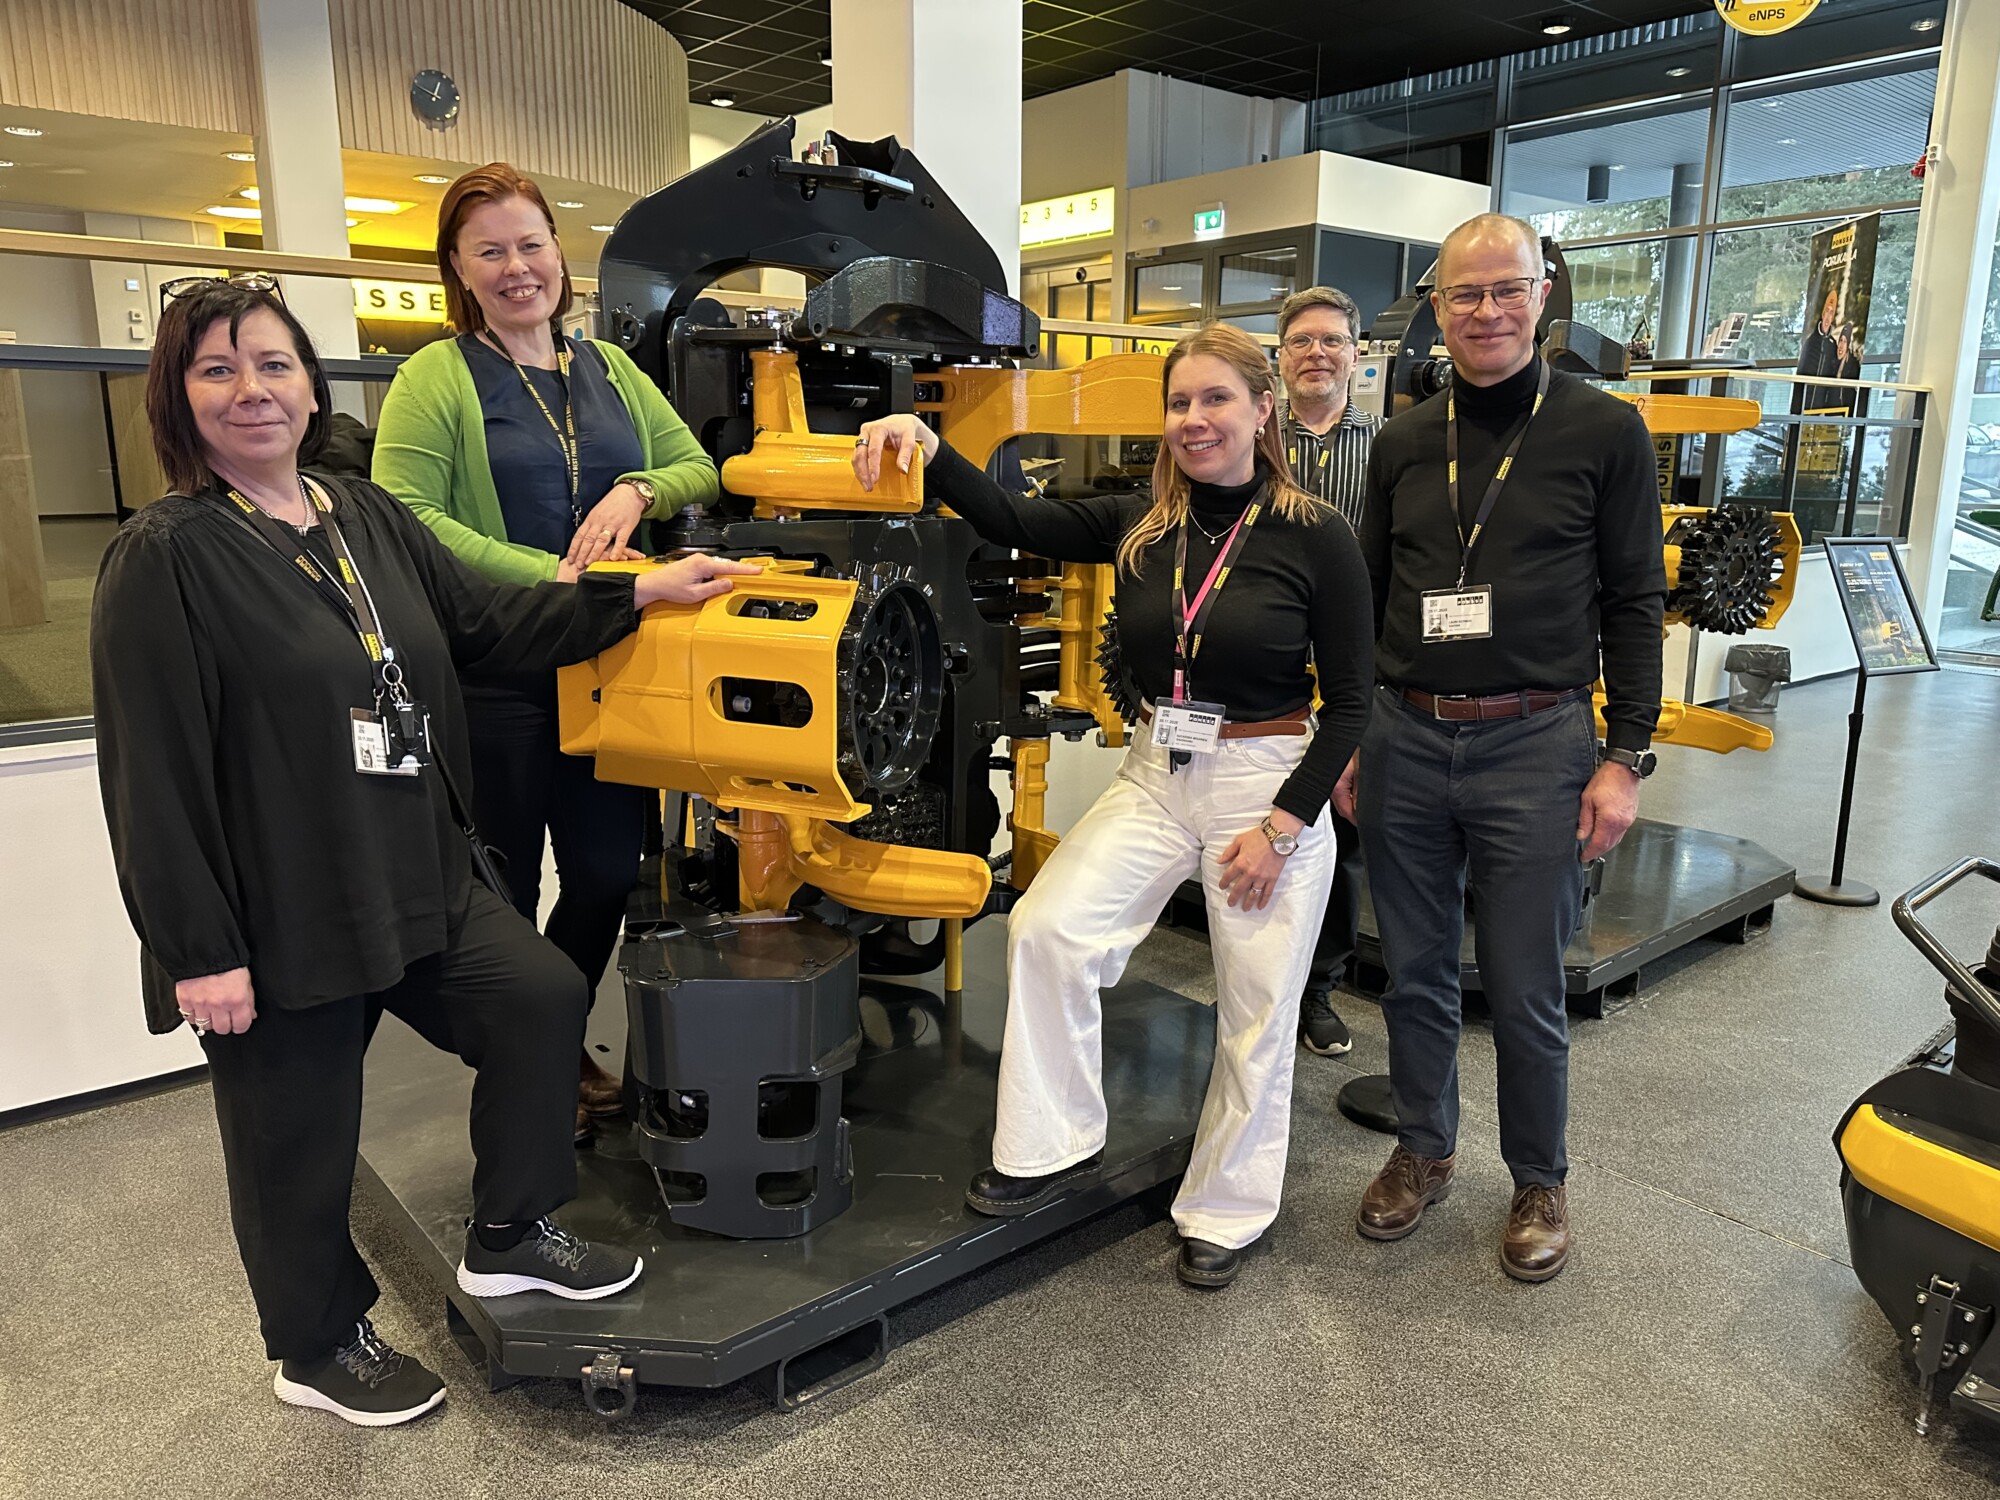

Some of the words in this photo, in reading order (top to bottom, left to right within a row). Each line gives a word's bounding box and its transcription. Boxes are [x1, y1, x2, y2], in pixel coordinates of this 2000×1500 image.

[1748, 8, 1786, 21] eNPS
[1022, 211, 1029, 224] 2
[1044, 207, 1051, 220] 3
[1066, 202, 1074, 215] 4
[1090, 198, 1098, 211] 5
[1832, 235, 1853, 246] PONSSE
[354, 288, 445, 311] SSE
